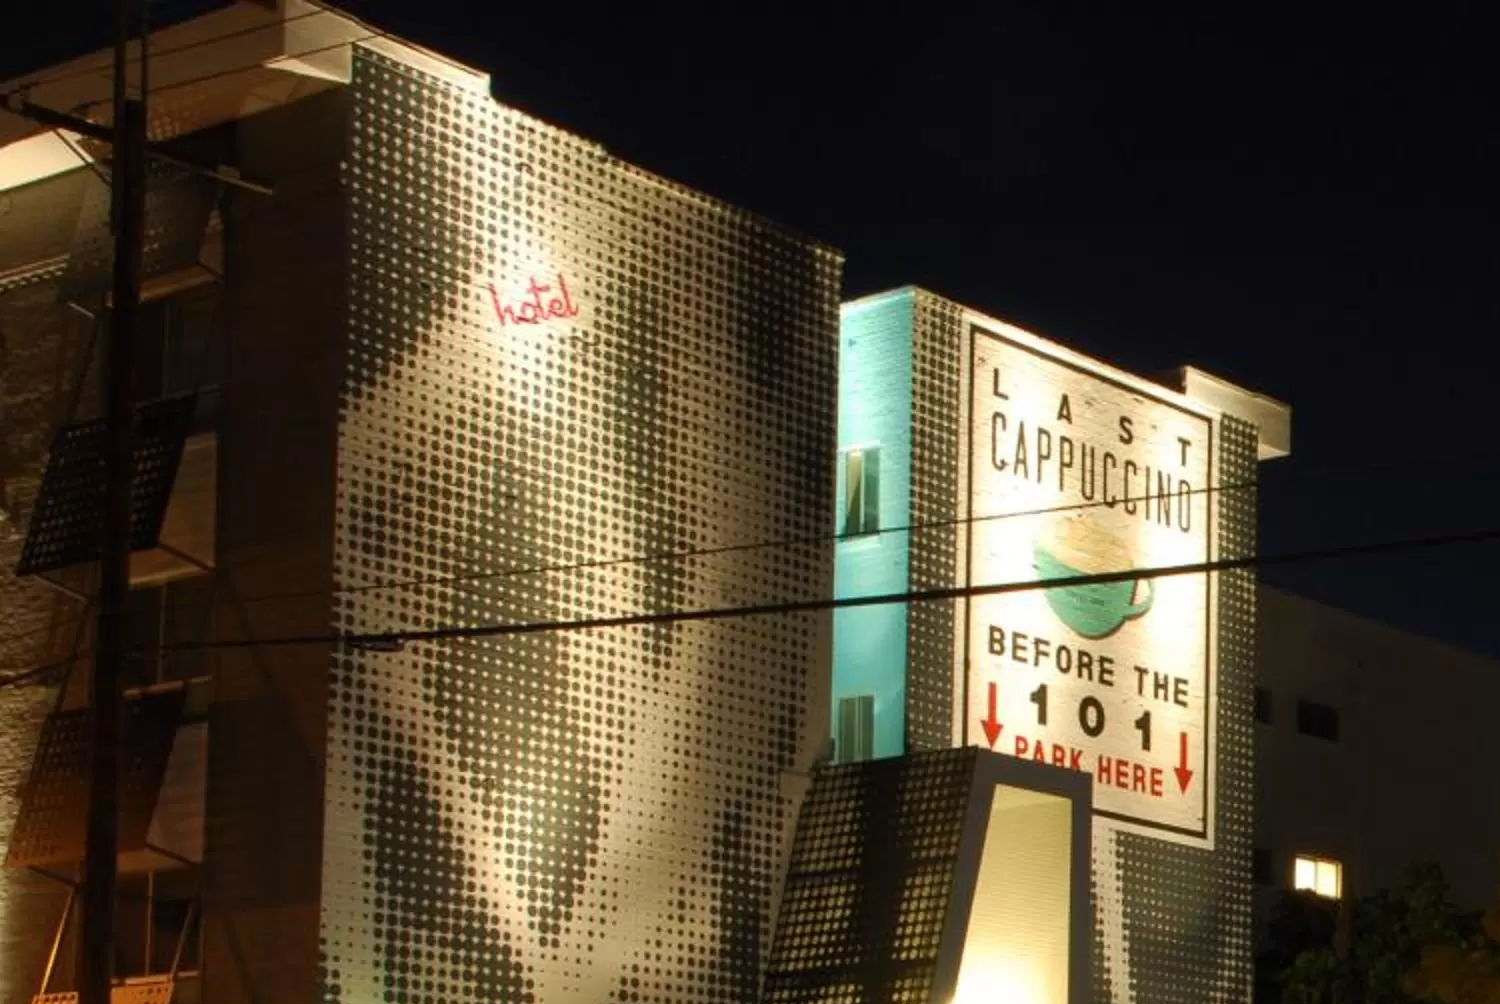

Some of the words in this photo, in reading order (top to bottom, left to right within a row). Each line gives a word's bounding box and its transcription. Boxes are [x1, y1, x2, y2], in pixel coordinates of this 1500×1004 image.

[487, 272, 579, 326] hotel
[991, 411, 1191, 533] CAPPUCCINO
[988, 624, 1115, 687] BEFORE
[1133, 665, 1189, 708] THE
[1014, 735, 1084, 773] PARK
[1097, 754, 1163, 798] HERE
